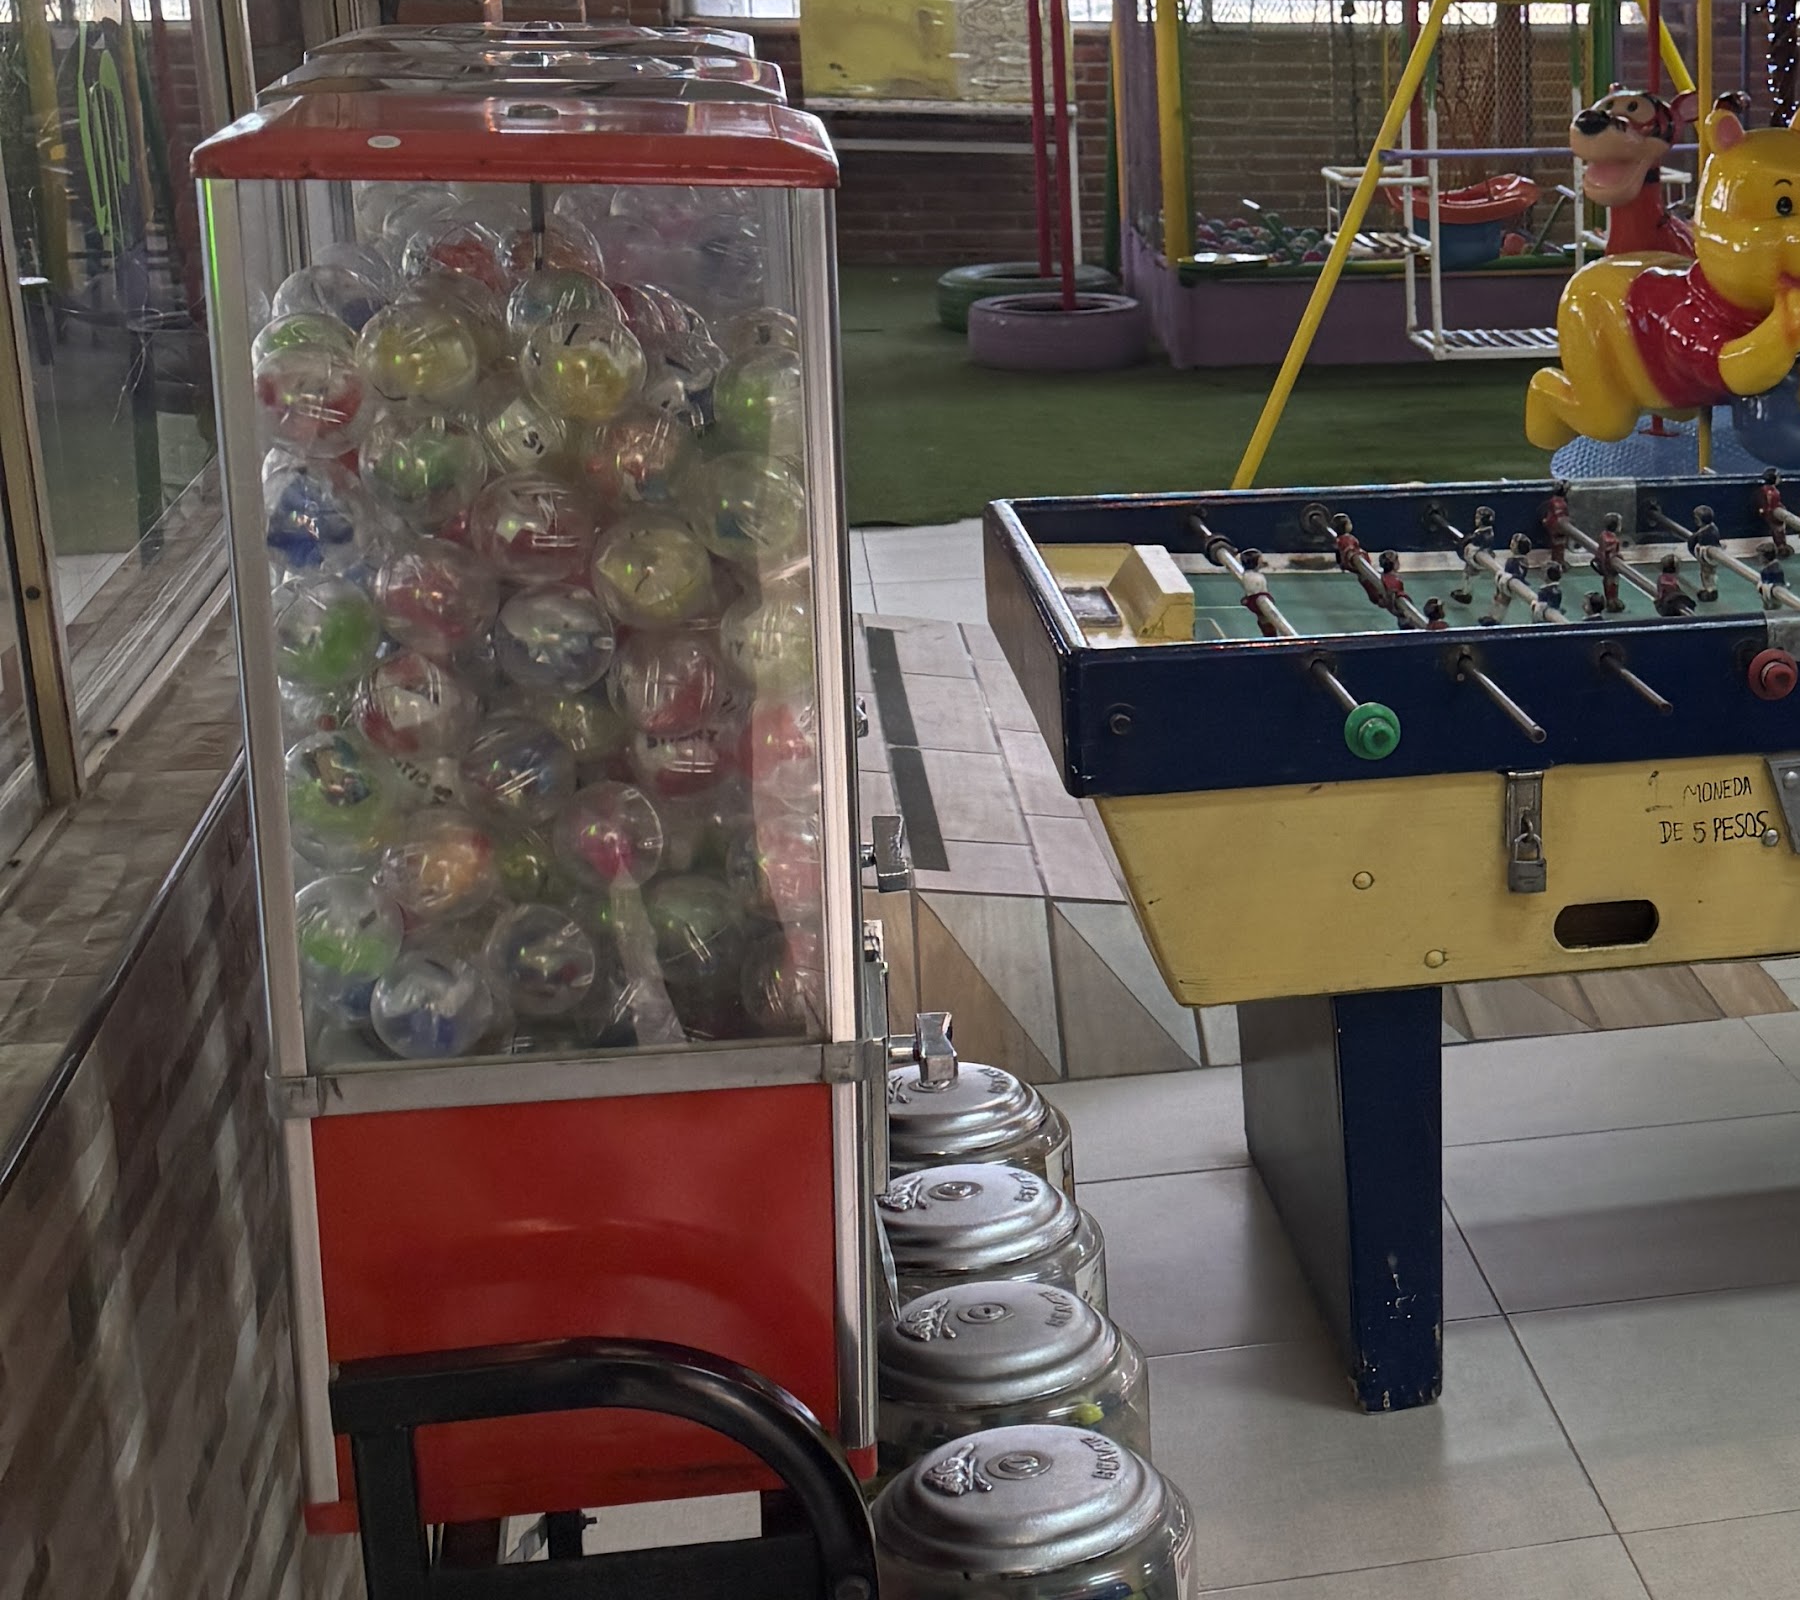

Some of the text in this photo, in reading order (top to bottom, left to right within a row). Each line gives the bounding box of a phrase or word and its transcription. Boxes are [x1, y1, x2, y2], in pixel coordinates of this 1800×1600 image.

[1683, 776, 1752, 806] MONEDA
[1659, 811, 1769, 844] DE 5 PESOS
